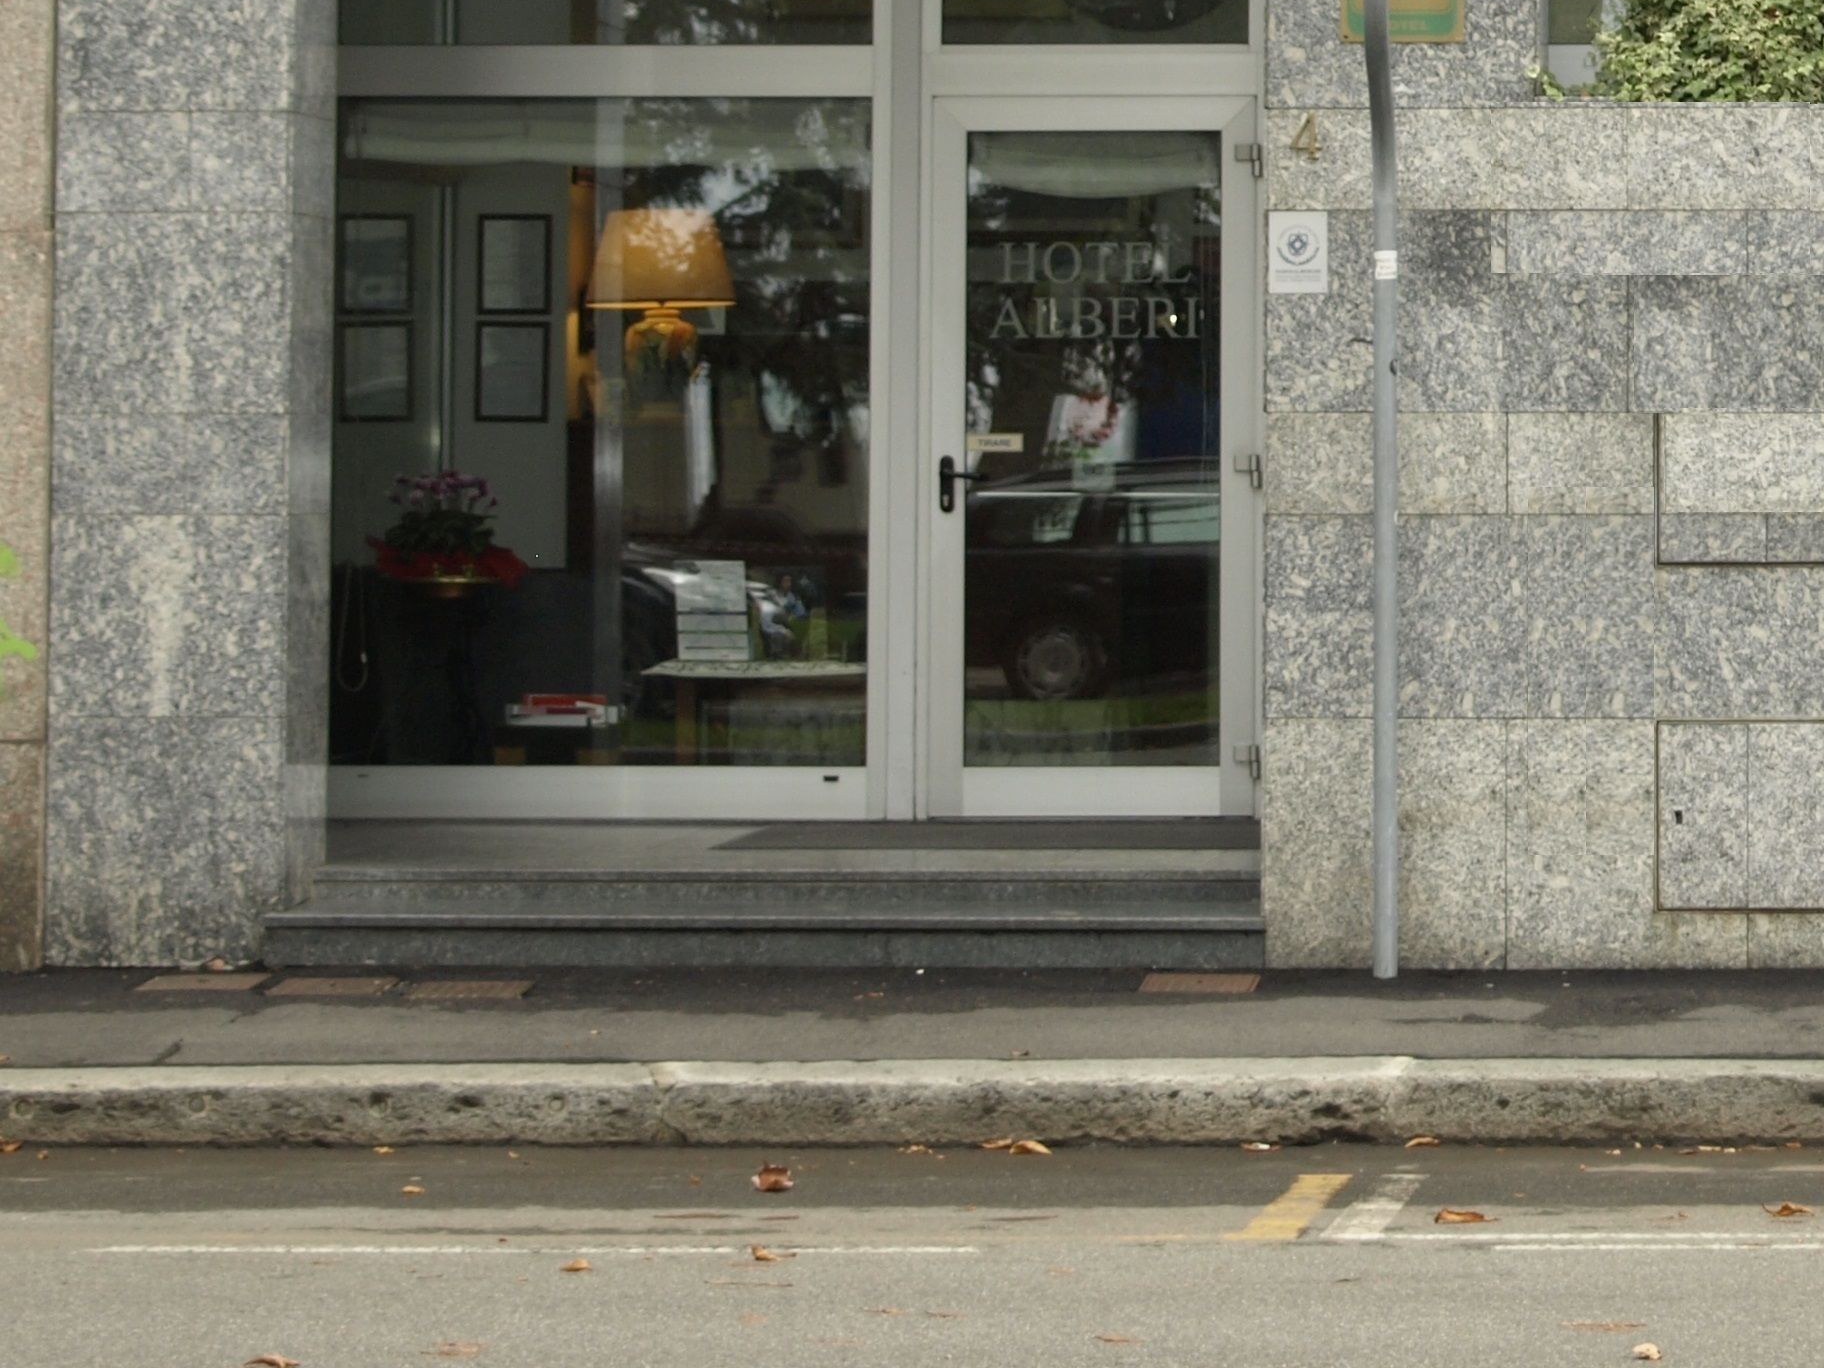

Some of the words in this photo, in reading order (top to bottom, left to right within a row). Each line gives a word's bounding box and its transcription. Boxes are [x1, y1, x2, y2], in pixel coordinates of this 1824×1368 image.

[1289, 112, 1322, 161] 4
[1001, 241, 1193, 284] HOTEL
[988, 296, 1201, 339] ALBERI
